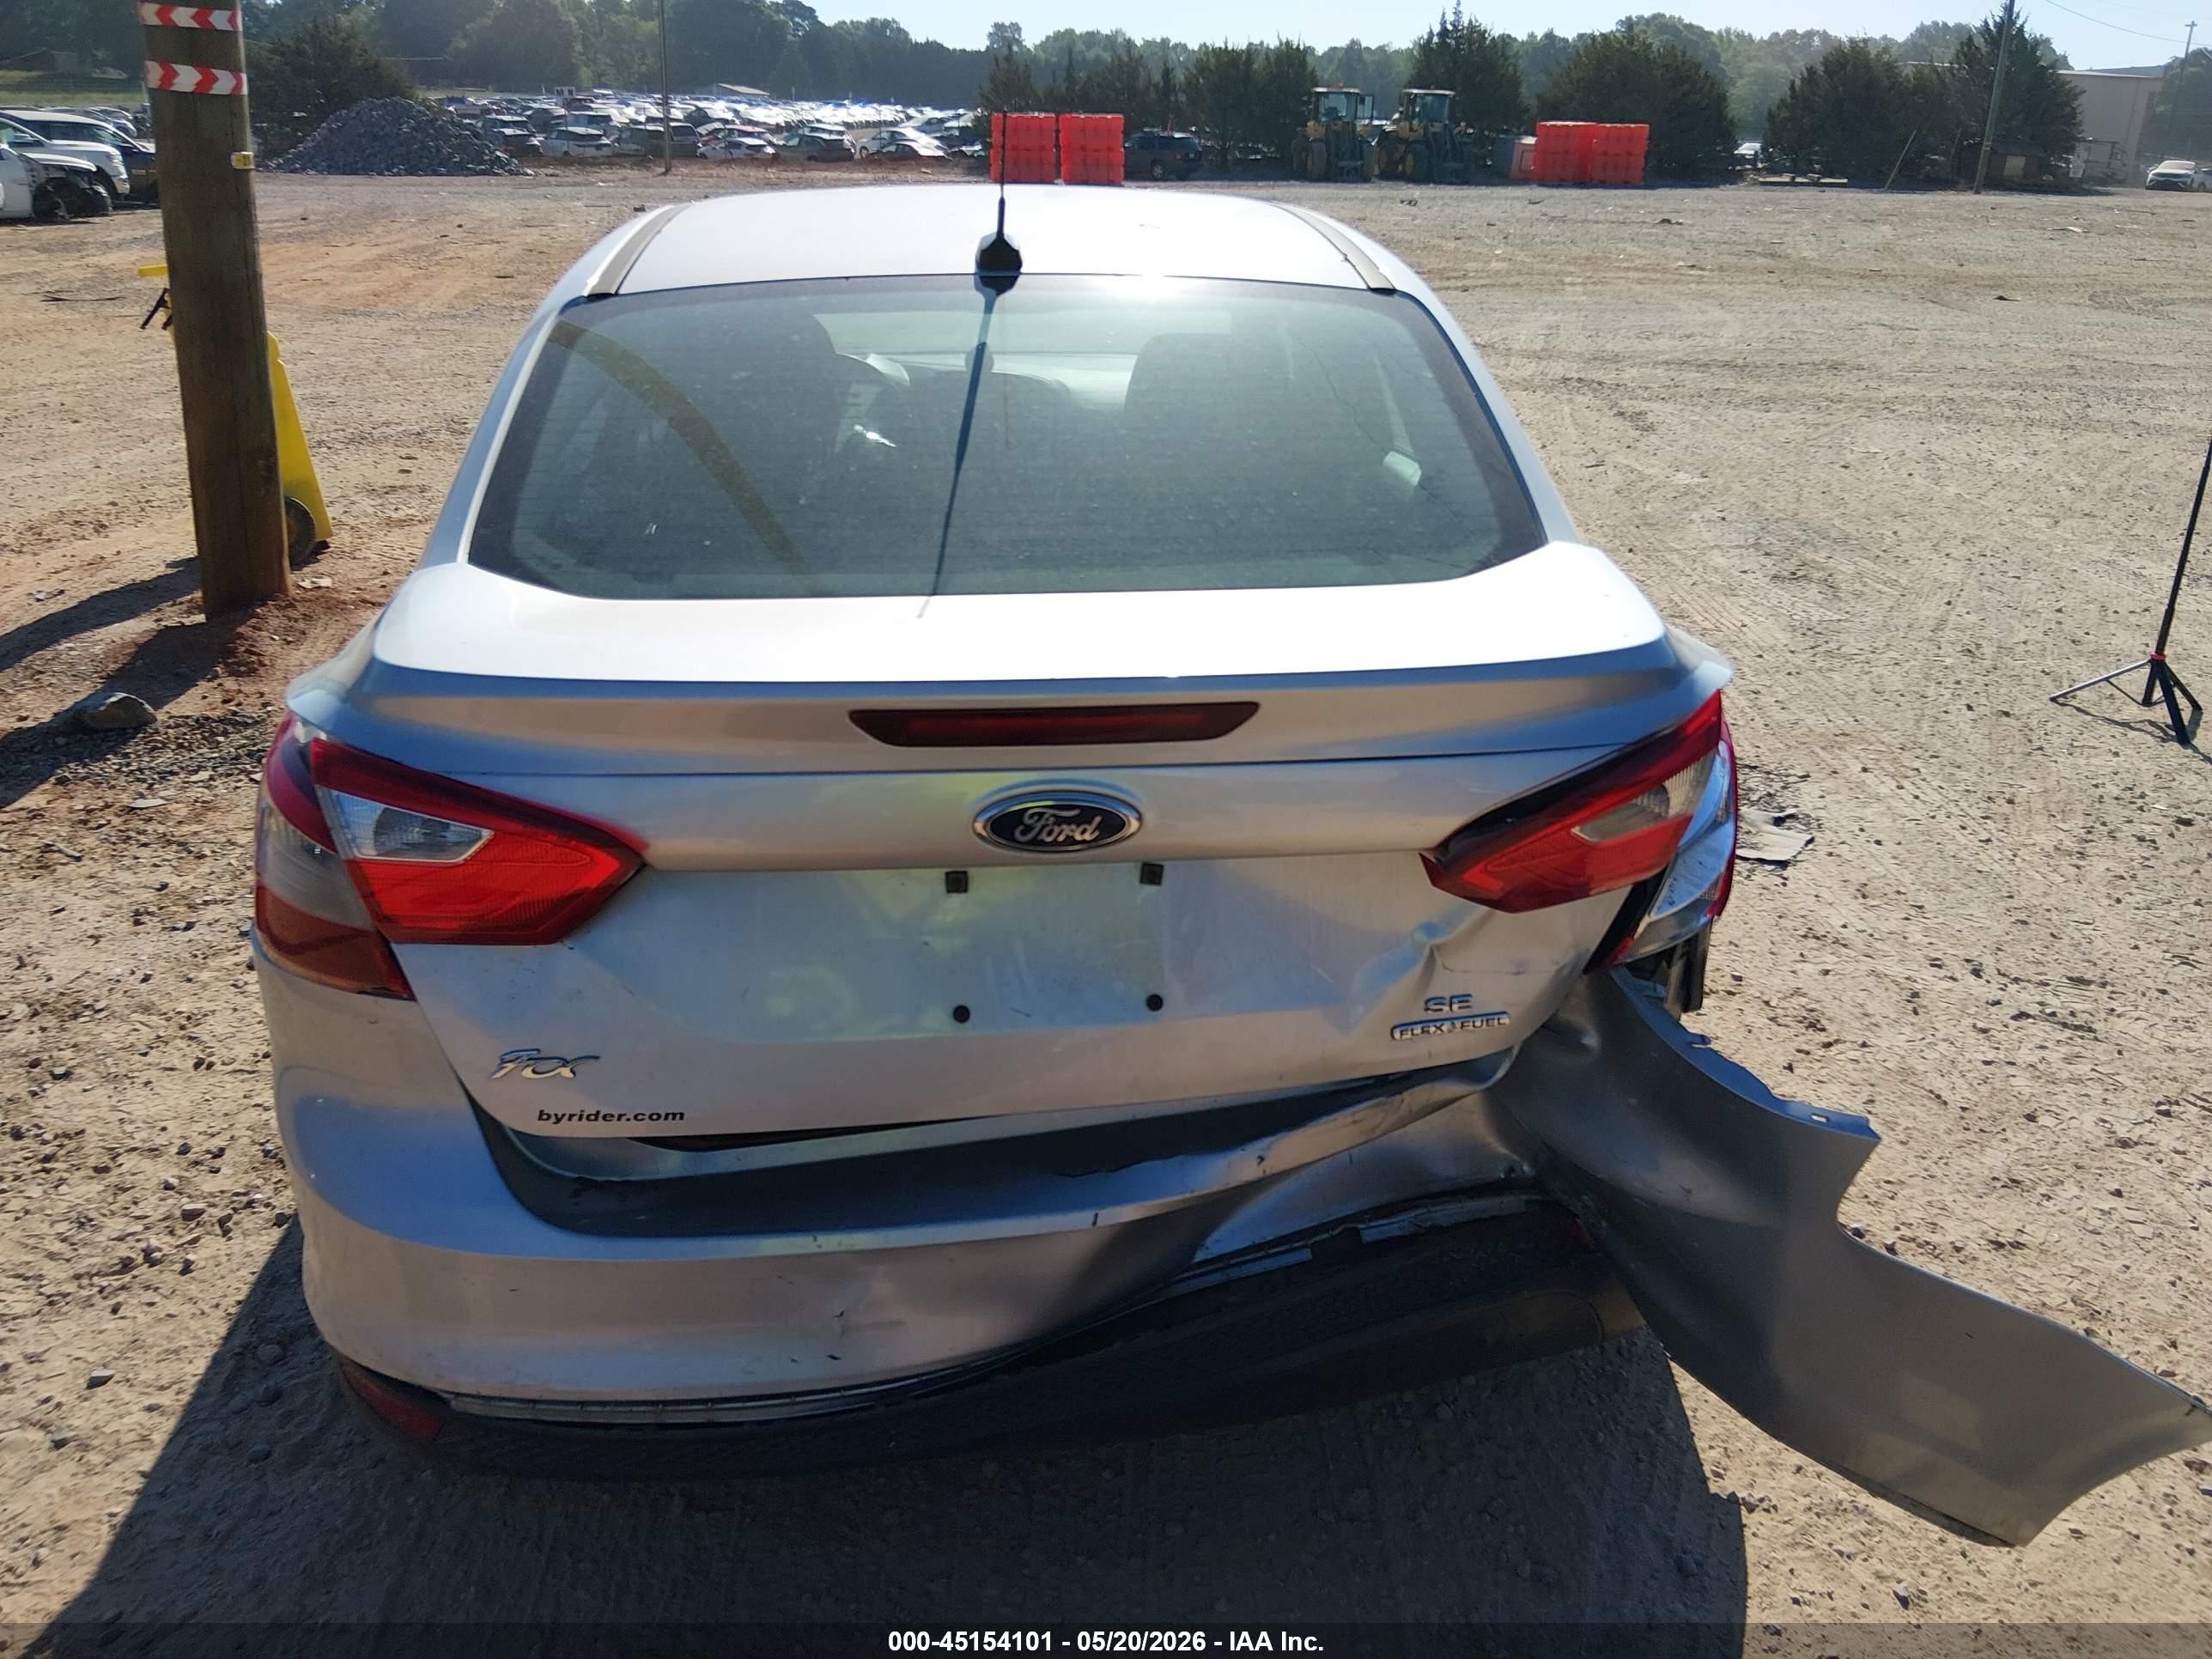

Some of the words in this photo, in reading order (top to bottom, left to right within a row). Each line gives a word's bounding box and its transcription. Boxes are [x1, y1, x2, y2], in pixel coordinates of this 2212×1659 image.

[1013, 807, 1103, 842] Ford
[1424, 994, 1473, 1013] SE
[1400, 1022, 1445, 1040] FLEX
[1459, 1016, 1510, 1031] FUEL
[537, 1109, 685, 1125] byrider.com
